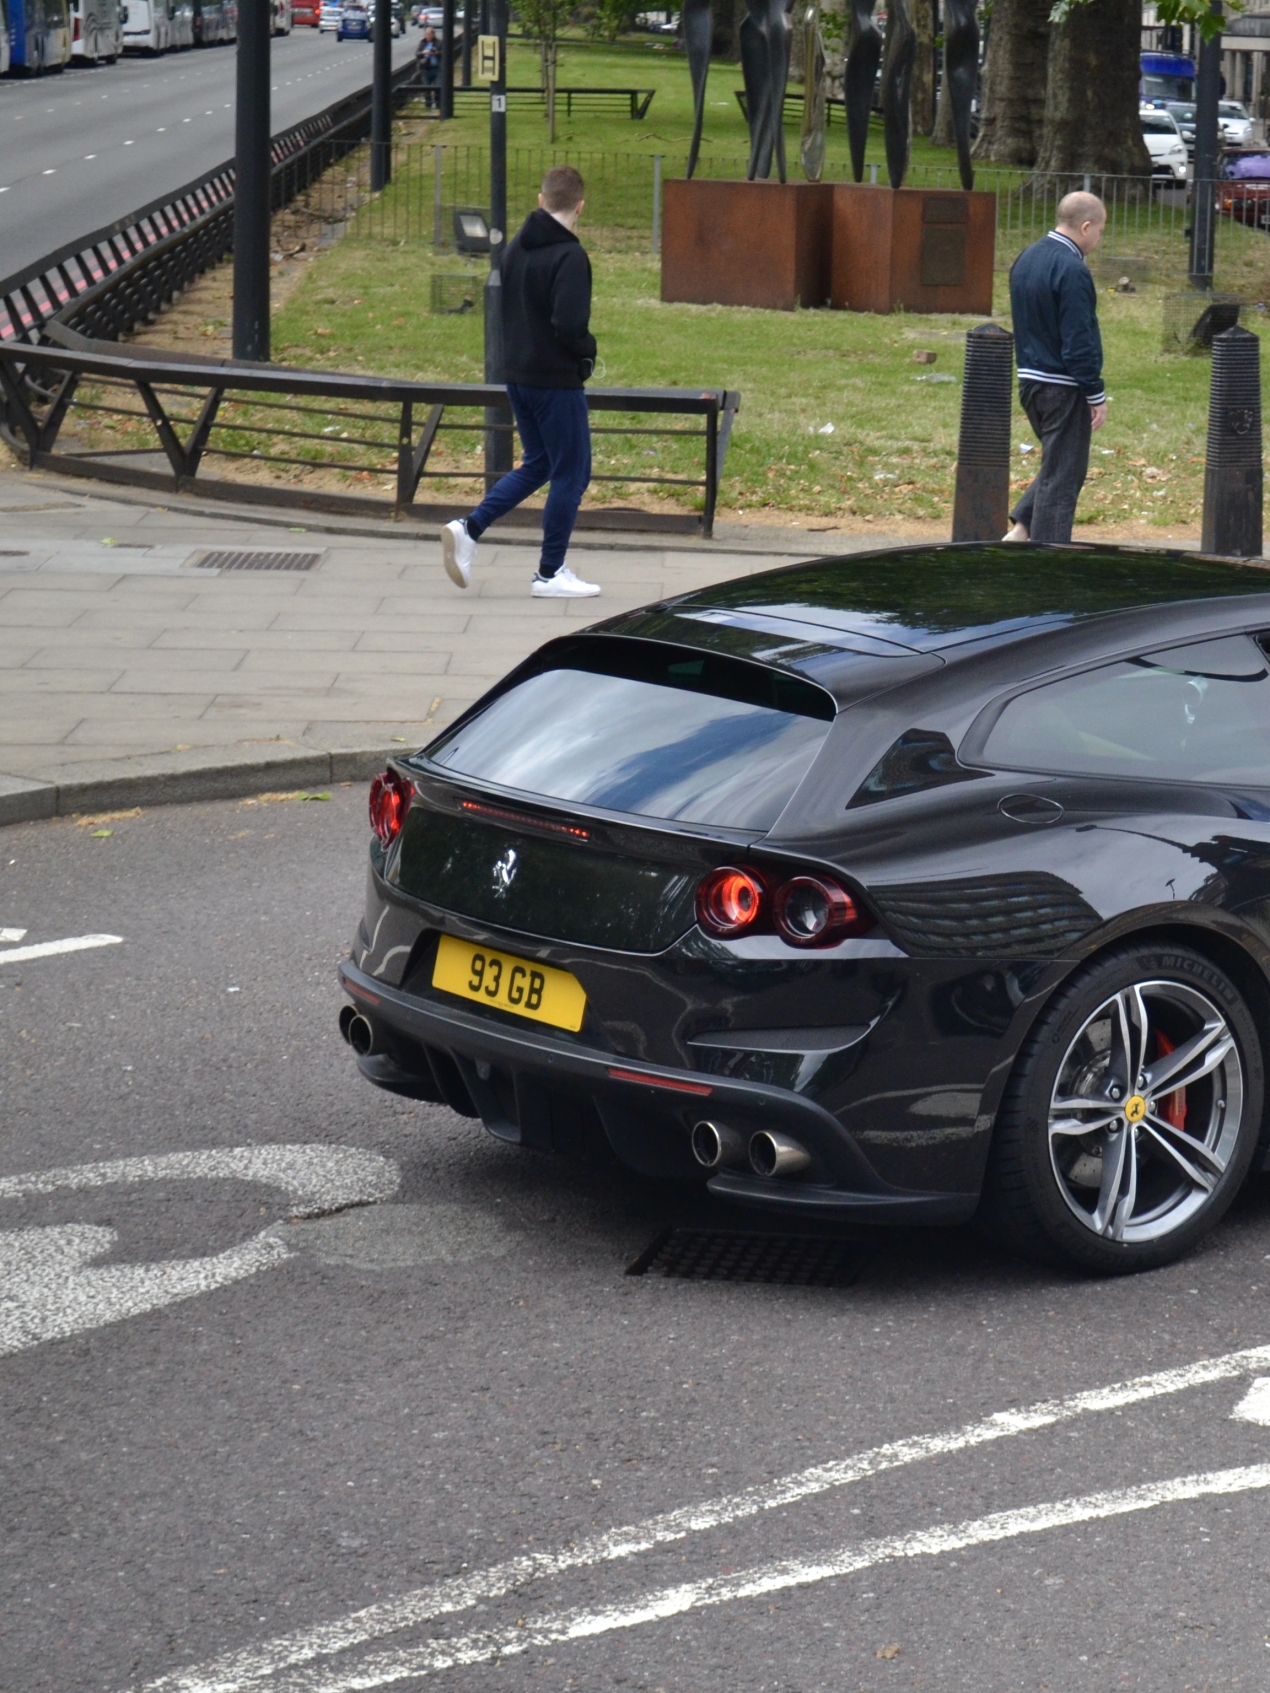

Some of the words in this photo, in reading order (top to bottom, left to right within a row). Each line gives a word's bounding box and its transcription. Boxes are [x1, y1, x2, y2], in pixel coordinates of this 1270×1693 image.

[481, 40, 496, 76] H
[496, 97, 502, 109] 1
[468, 953, 503, 998] 93
[507, 965, 545, 1011] GB
[1161, 955, 1236, 1001] MICHELIN
